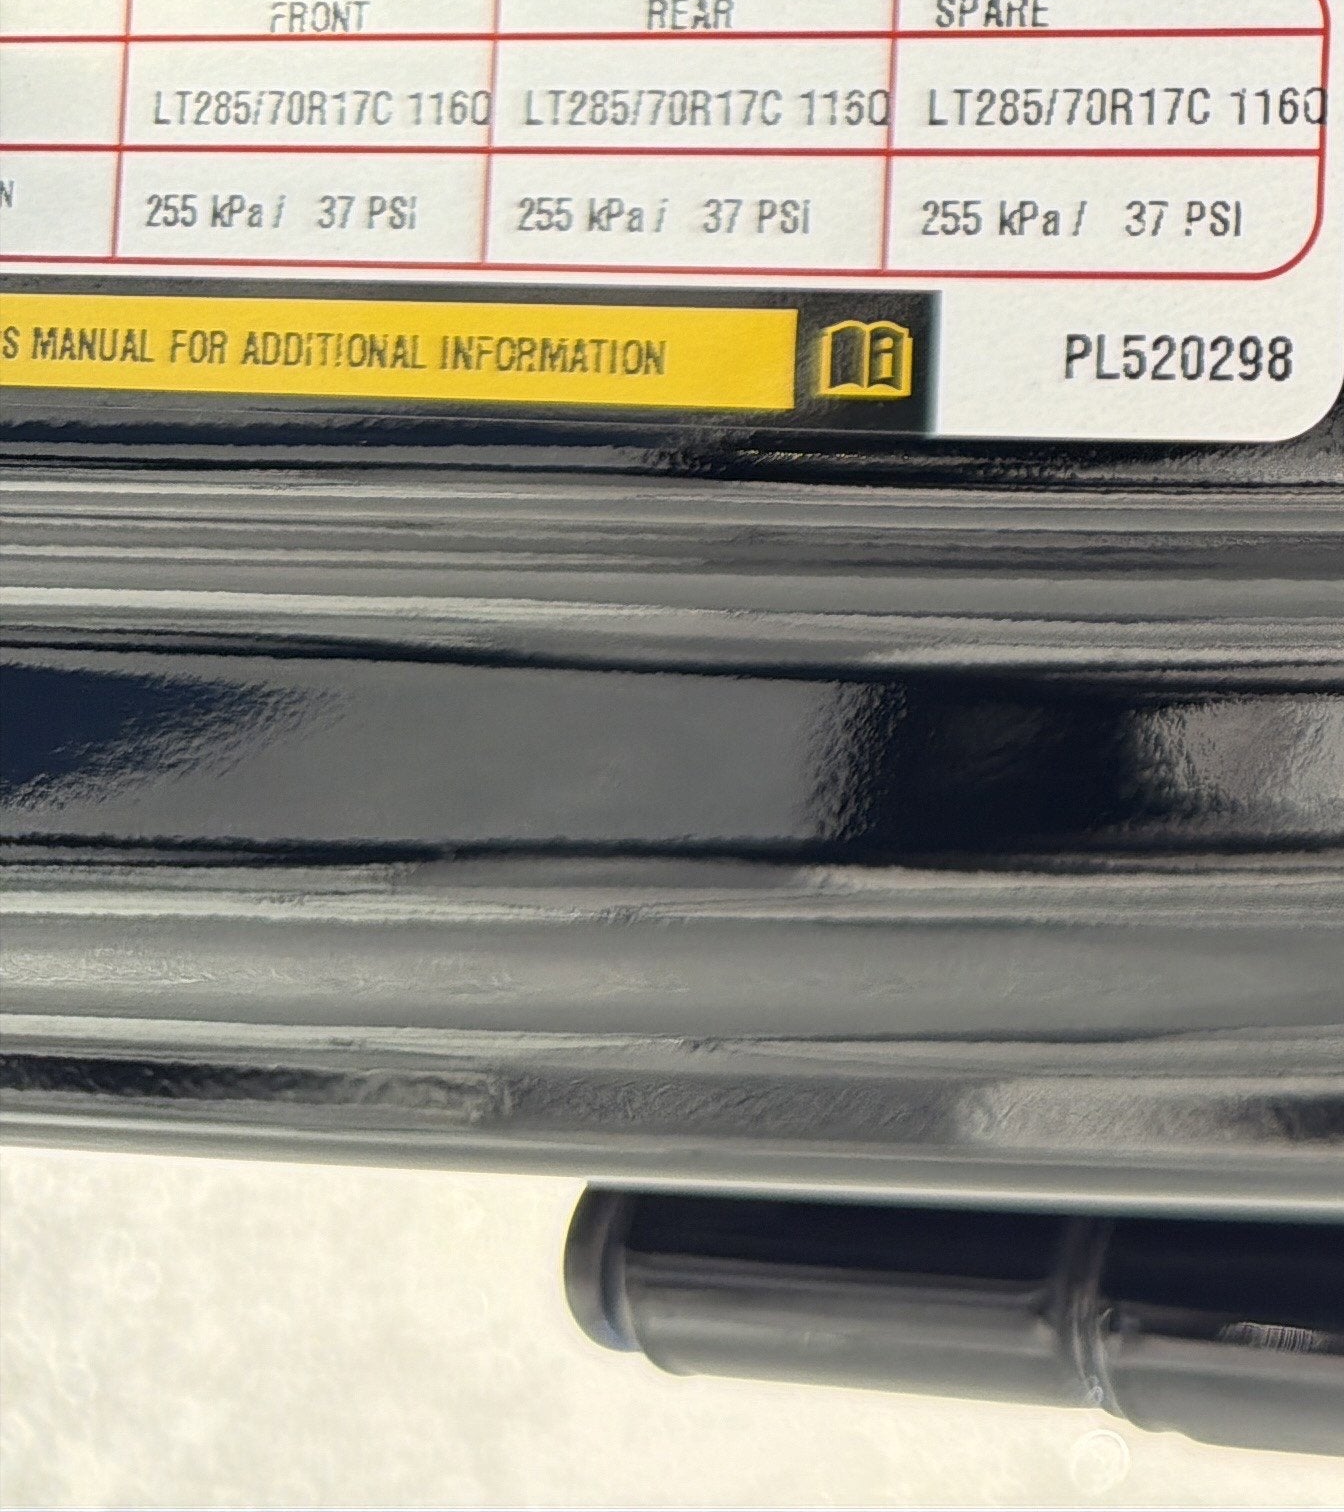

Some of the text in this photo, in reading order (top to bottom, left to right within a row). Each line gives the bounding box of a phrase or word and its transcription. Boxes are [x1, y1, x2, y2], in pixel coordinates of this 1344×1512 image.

[270, 0, 371, 33] FRONT
[153, 90, 392, 125] LT285/70R17C
[524, 89, 782, 126] LT285/70R17C
[928, 88, 1210, 126] LT285/70R17C
[145, 194, 196, 227] 255
[210, 195, 262, 227] kPa
[316, 195, 355, 229] 37
[367, 196, 416, 229] PSI
[516, 197, 572, 231] 255
[587, 198, 643, 232] kPa
[701, 199, 742, 233] 37
[757, 199, 809, 234] PSI
[921, 201, 981, 235] 255
[999, 201, 1059, 236] kPa
[1125, 201, 1168, 236] 37
[1185, 201, 1241, 236] PSI
[32, 327, 154, 362] MANUAL
[169, 330, 227, 364] FOR
[240, 331, 426, 369] ADDITIONAL
[439, 336, 665, 374] INFORMATION
[1065, 334, 1292, 381] PL520298
